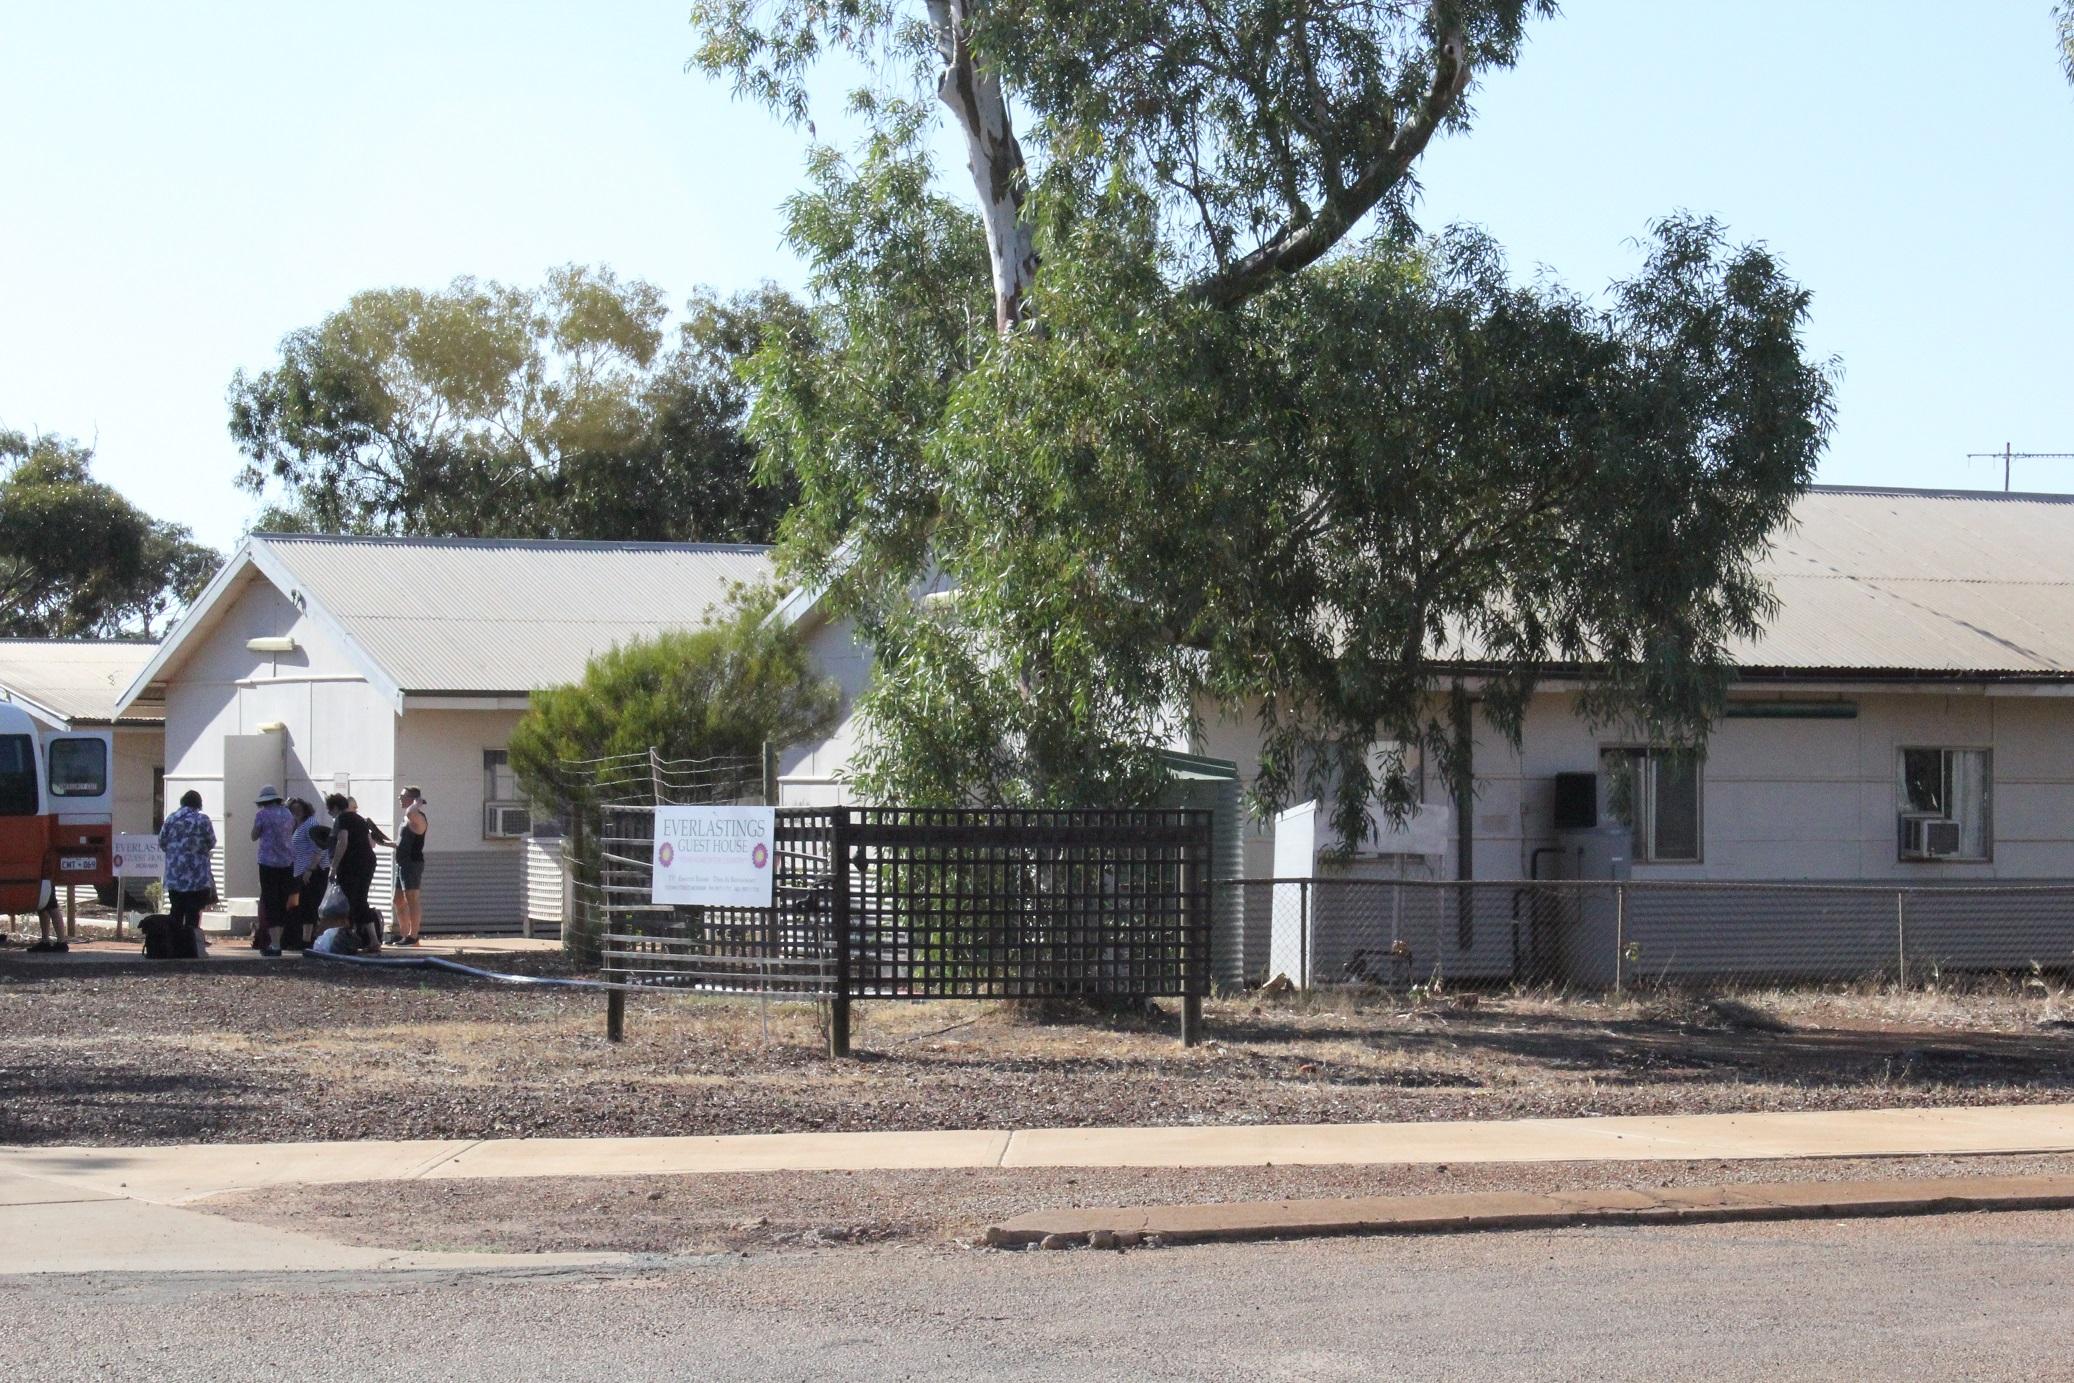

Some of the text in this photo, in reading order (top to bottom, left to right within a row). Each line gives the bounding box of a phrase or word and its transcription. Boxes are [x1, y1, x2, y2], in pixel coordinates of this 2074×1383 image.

[664, 818, 766, 838] EVERLASTINGS
[678, 839, 749, 853] GUEST HOUSE
